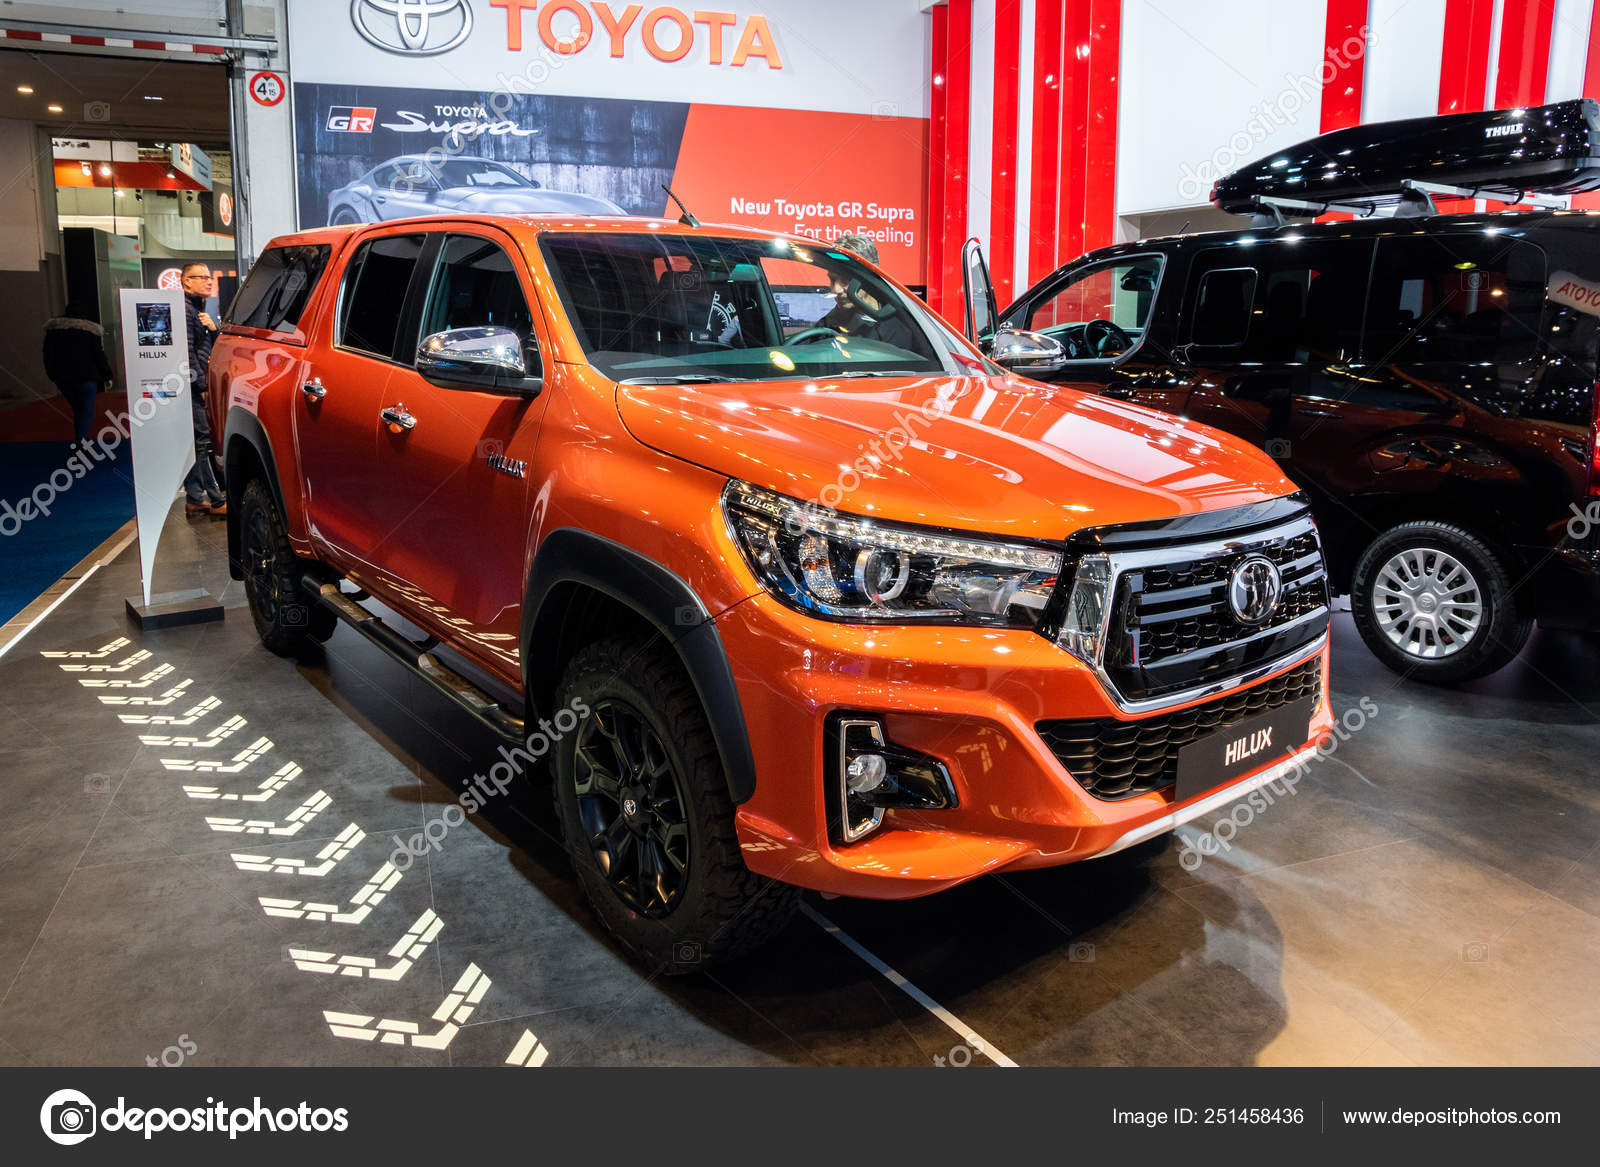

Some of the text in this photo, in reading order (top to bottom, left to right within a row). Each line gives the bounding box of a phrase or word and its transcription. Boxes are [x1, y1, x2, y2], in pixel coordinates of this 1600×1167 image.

[490, 0, 783, 70] TOYOTA
[257, 82, 267, 96] 4
[434, 105, 488, 118] TOYOTA
[380, 110, 539, 147] Supra
[1485, 122, 1525, 138] THULE
[731, 197, 915, 223] New Toyota GR Supra
[856, 226, 914, 247] Feeling
[139, 351, 168, 359] HILUX
[487, 452, 528, 479] HILUX
[1224, 726, 1273, 767] HILUX
